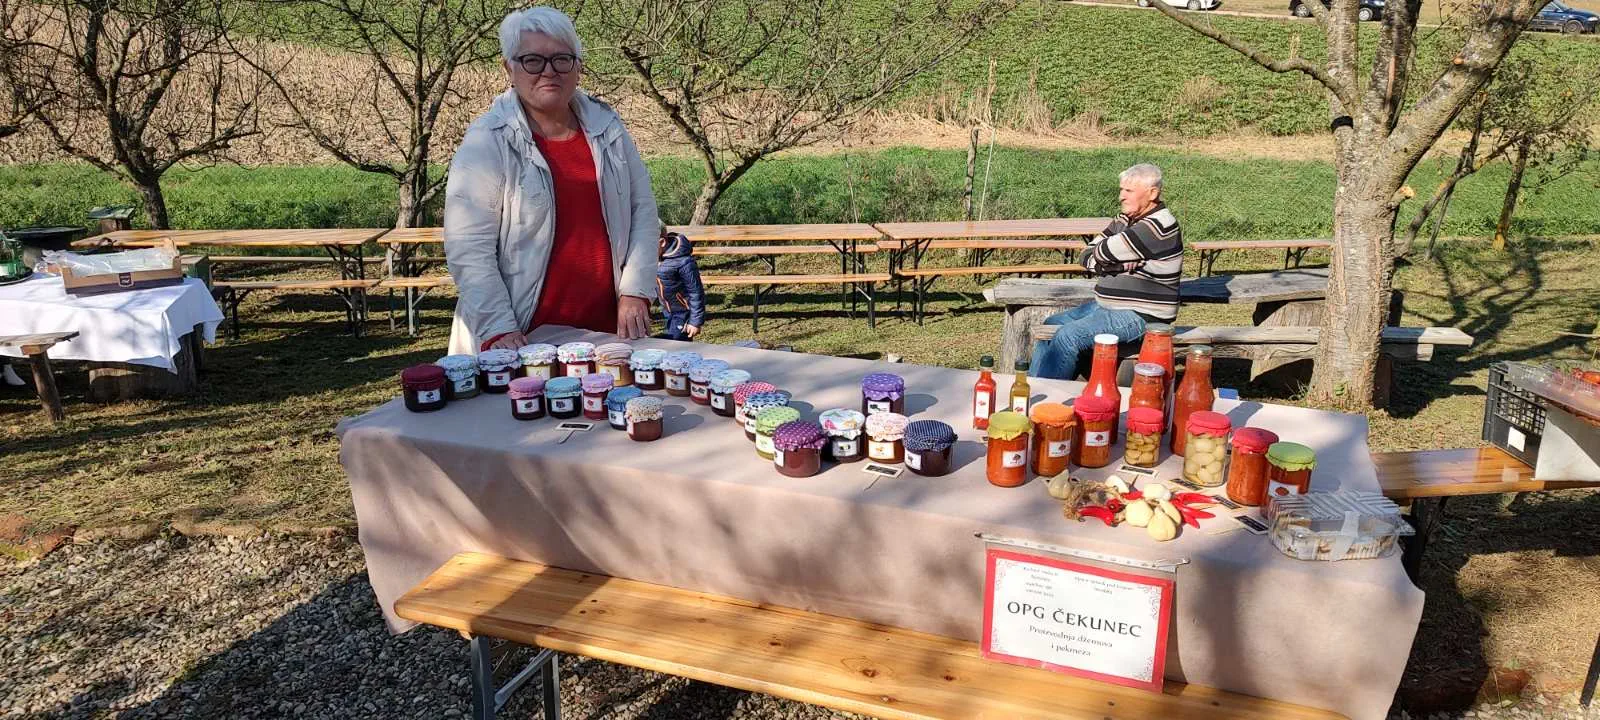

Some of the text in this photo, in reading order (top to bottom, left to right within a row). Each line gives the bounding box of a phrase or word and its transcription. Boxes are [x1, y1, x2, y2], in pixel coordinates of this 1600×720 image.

[1007, 601, 1142, 638] OPG ČEKUNEC
[1029, 625, 1075, 641] Proizvodnja
